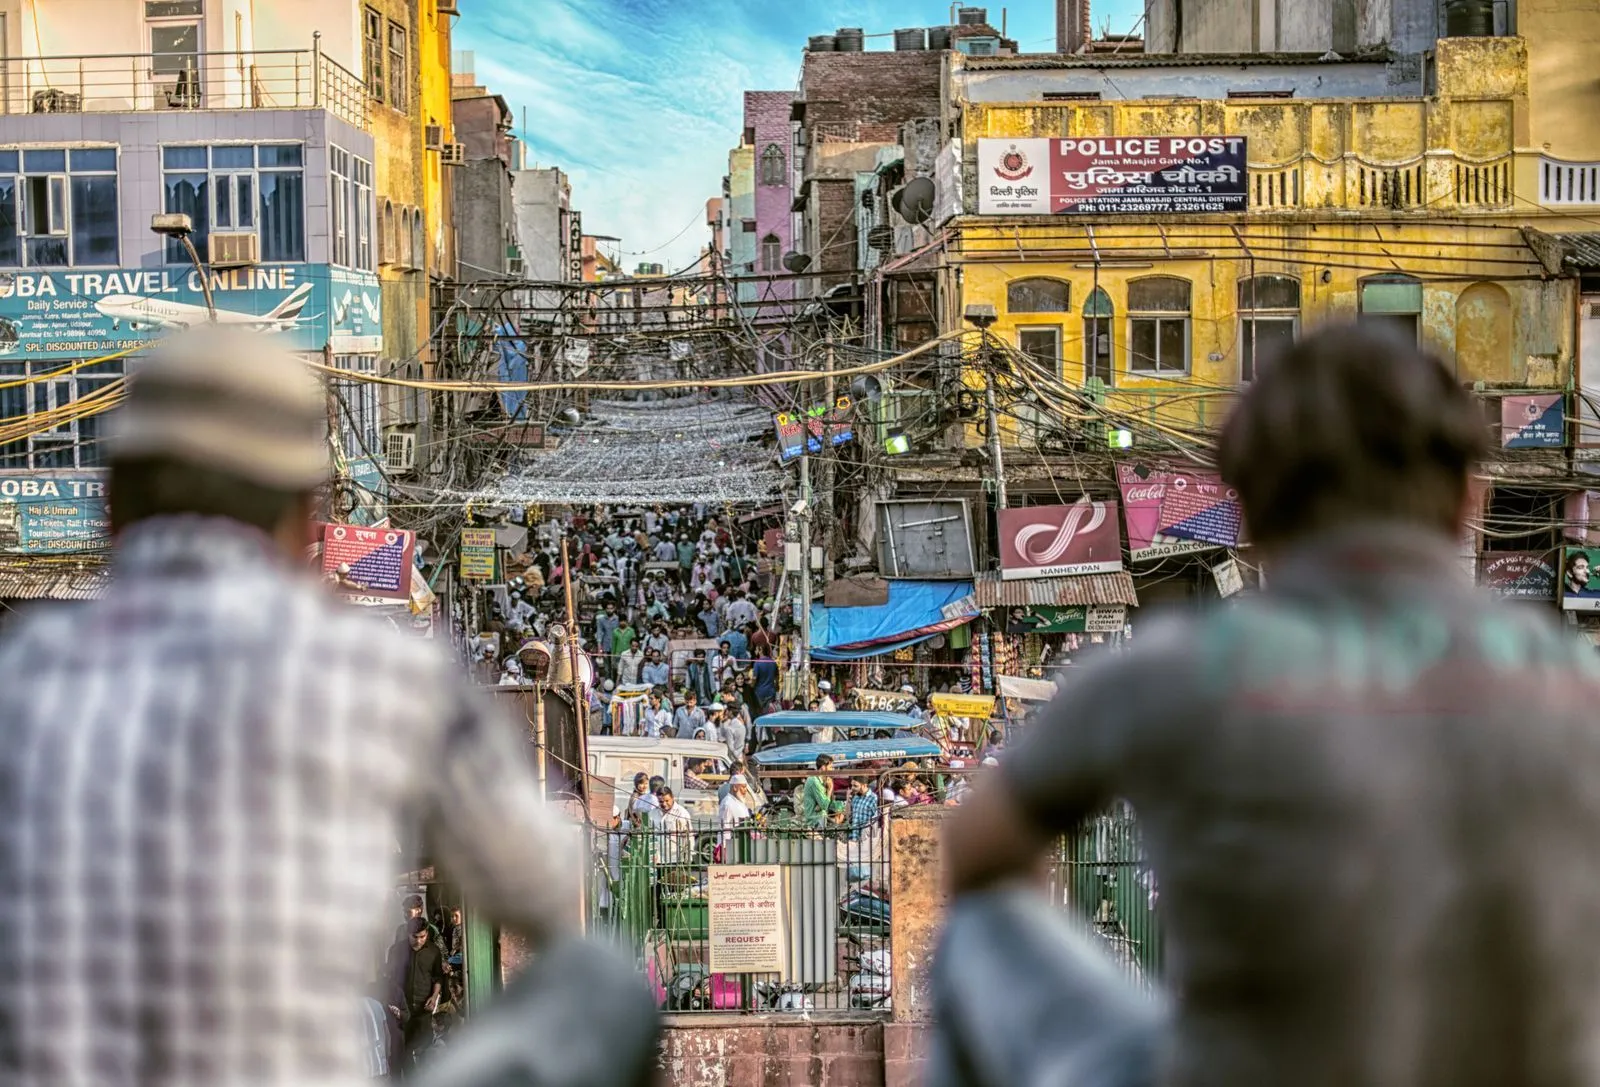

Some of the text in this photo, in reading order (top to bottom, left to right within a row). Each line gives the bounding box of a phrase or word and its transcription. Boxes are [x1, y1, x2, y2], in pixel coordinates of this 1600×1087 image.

[1060, 138, 1244, 156] POLICE POST
[1123, 157, 1156, 166] Masjid
[1187, 156, 1210, 164] No.1
[1062, 164, 1241, 190] पुलिस चौकी
[990, 185, 1038, 199] दिल्ली पुलिस
[1078, 204, 1097, 212] PH:
[65, 271, 179, 295] TRAVEL
[187, 267, 295, 291] ONLINE
[28, 300, 50, 311] Daily
[53, 299, 88, 309] Service
[25, 343, 44, 353] SPL:
[46, 341, 99, 352] DISCOUNTED
[101, 340, 115, 350] AIR
[117, 339, 144, 350] FARES
[28, 505, 78, 517] Haj & Umrah
[354, 529, 377, 542] सूचना
[48, 540, 98, 550] DISCOUNTED
[1136, 548, 1171, 560] ASHFAQ
[1173, 544, 1190, 554] PAN
[1040, 564, 1101, 576] NANHEY PAN
[856, 749, 907, 758] Saksham
[748, 900, 755, 909] से
[757, 900, 776, 909] अपील
[725, 936, 766, 944] REQUEST
